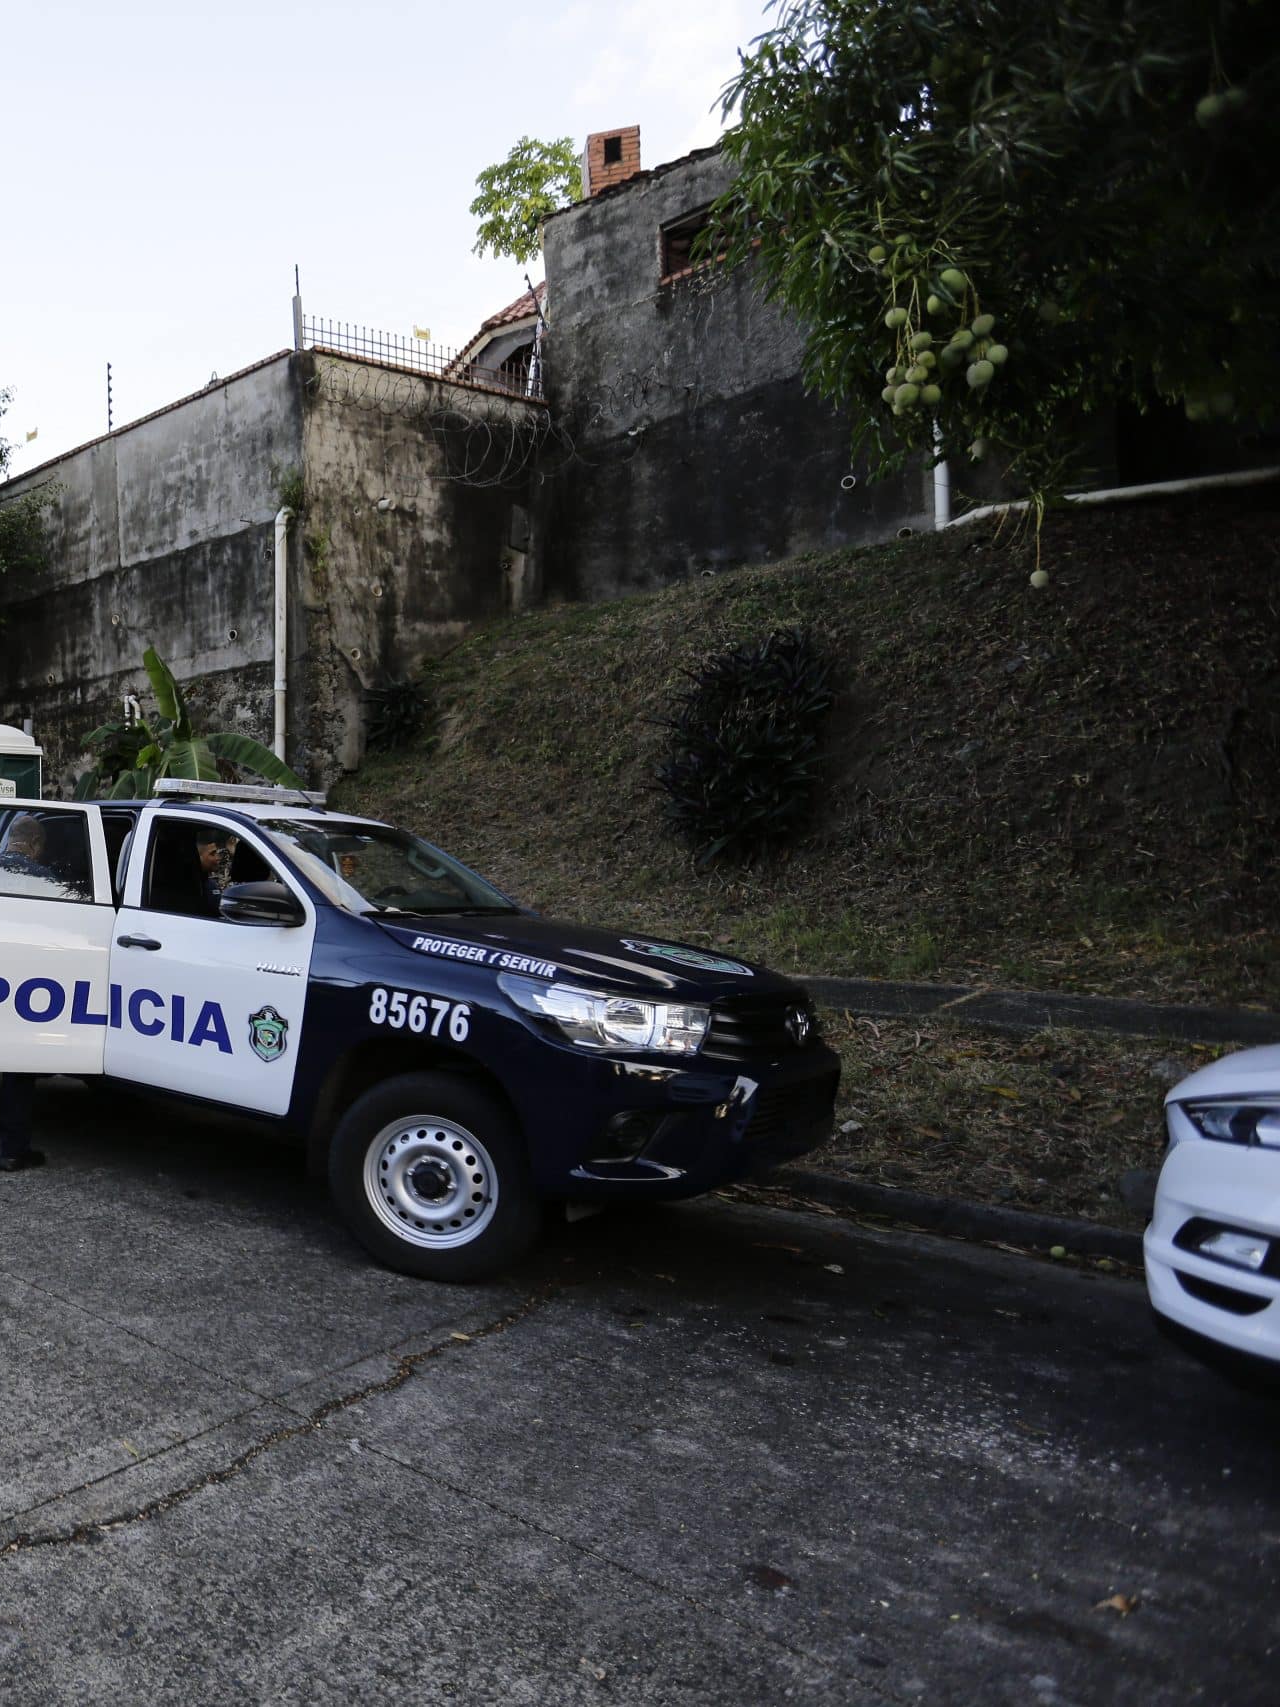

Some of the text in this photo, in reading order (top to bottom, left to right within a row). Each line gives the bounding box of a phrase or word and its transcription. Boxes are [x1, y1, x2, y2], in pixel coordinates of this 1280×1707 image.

[412, 936, 487, 962] PROTEGER
[499, 953, 557, 978] SERVIR
[369, 987, 471, 1042] 85676
